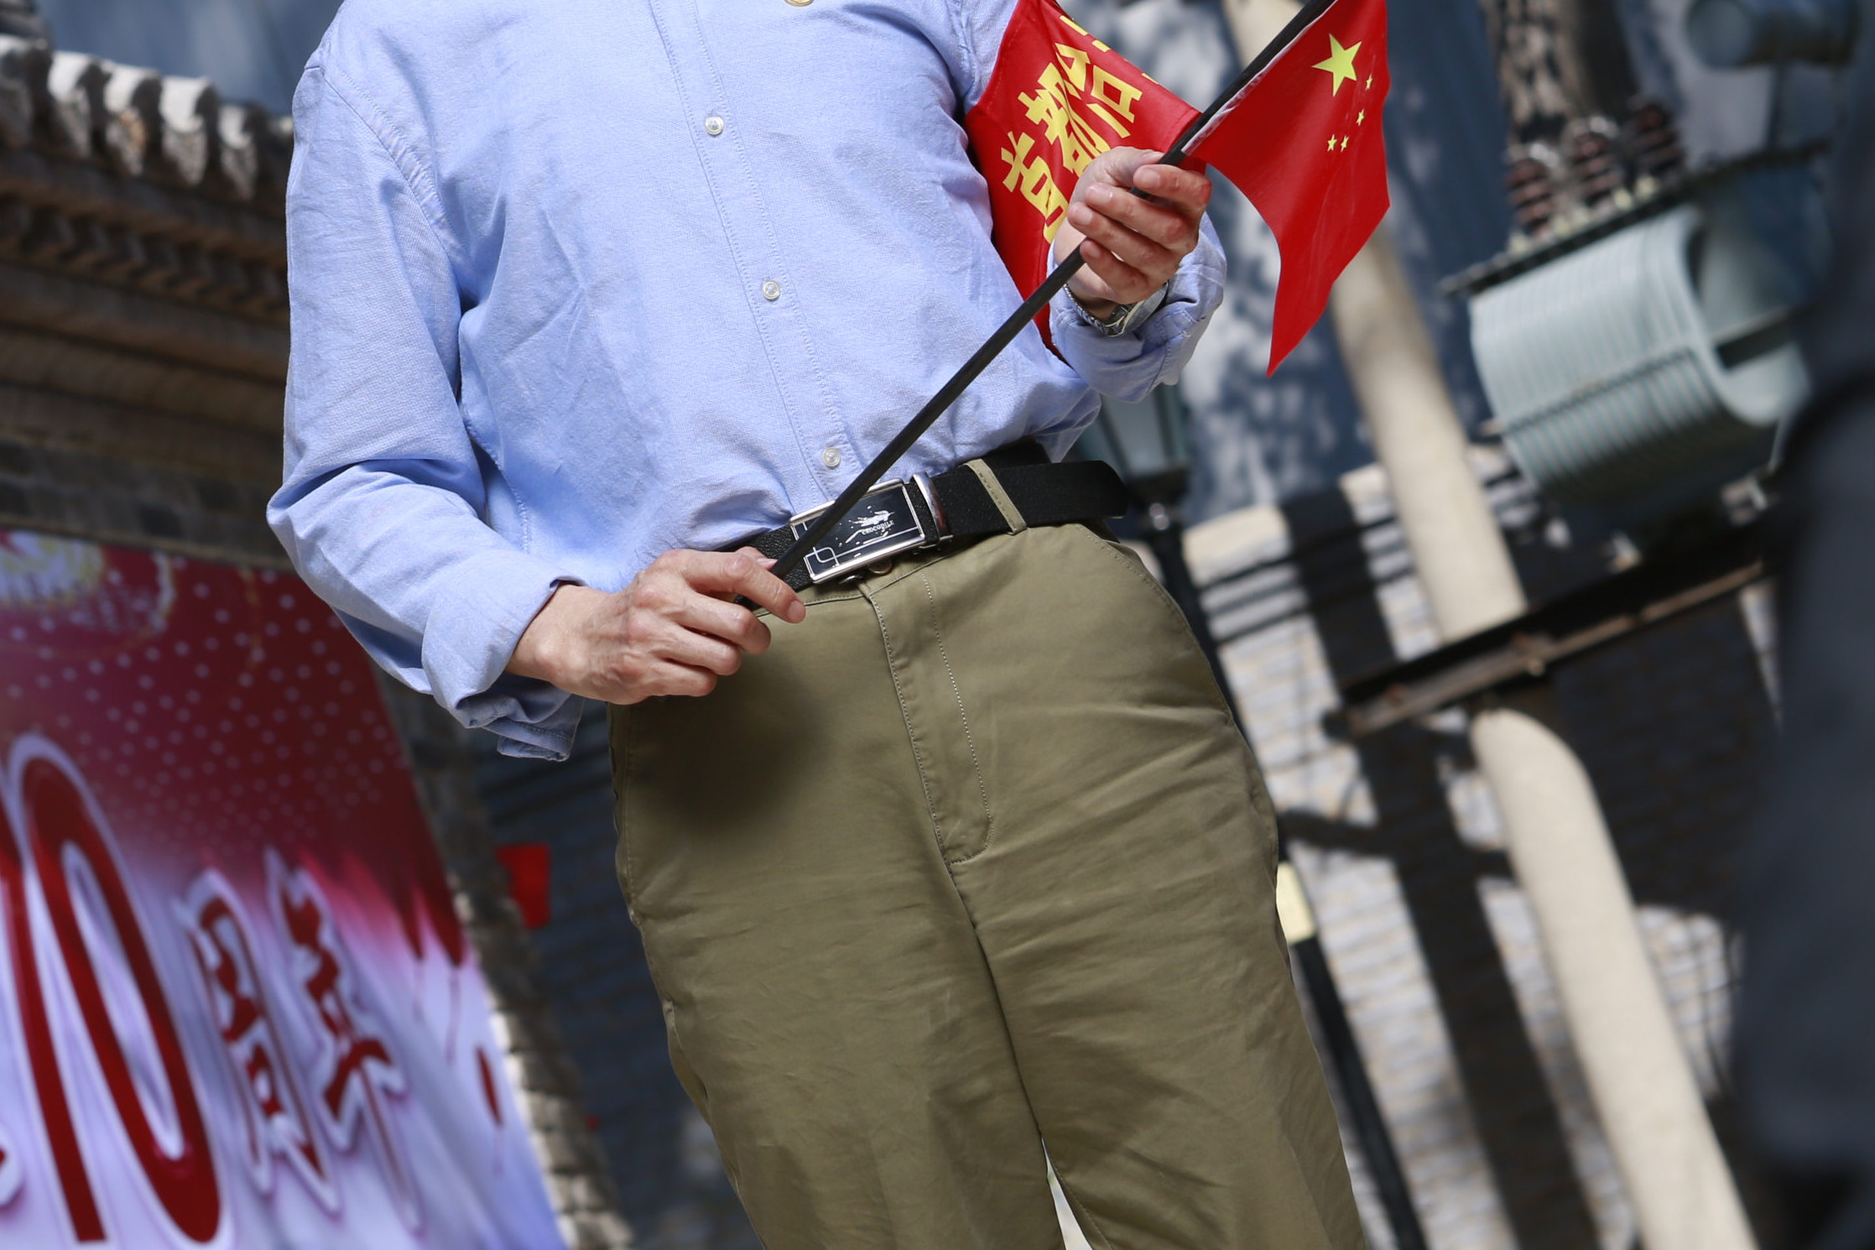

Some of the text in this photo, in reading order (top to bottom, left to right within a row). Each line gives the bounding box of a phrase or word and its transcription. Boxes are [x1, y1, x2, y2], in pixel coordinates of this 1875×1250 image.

[999, 14, 1159, 245] 首都治
[861, 519, 895, 535] CROCODILE
